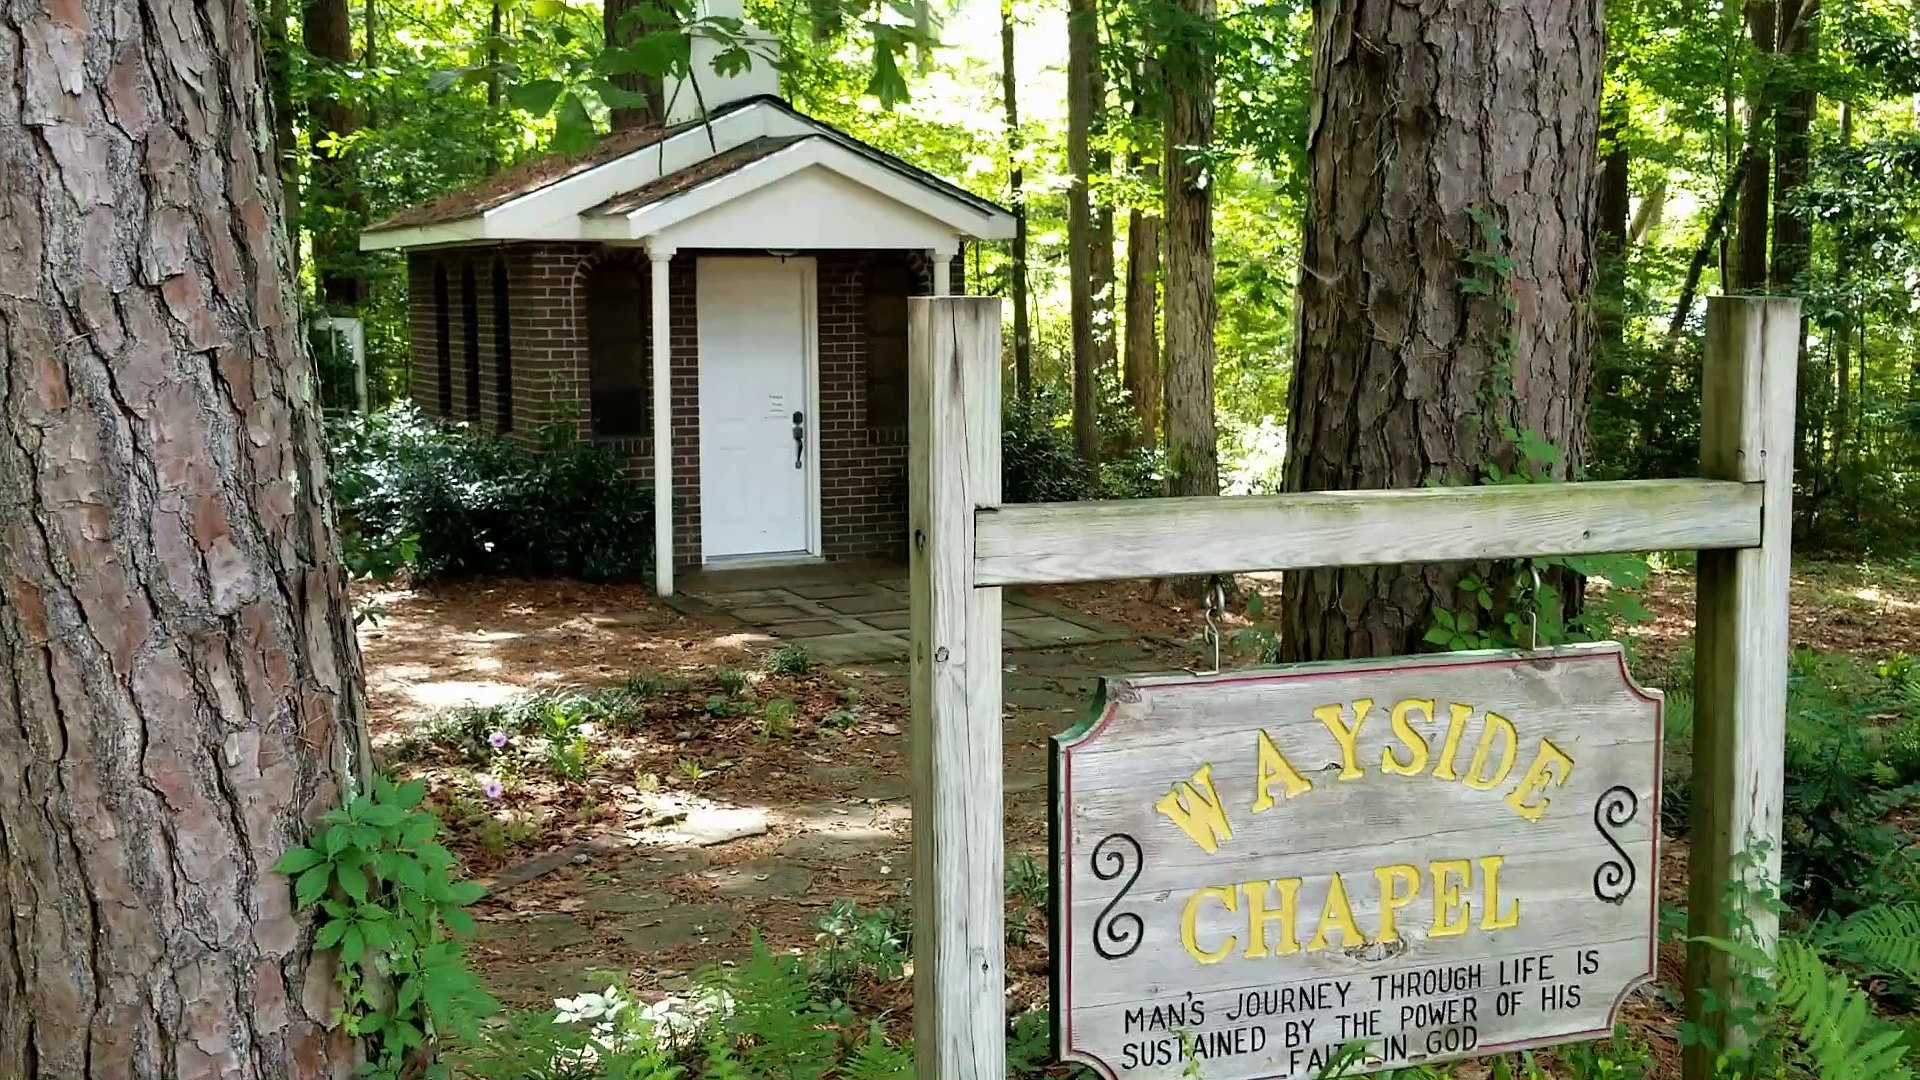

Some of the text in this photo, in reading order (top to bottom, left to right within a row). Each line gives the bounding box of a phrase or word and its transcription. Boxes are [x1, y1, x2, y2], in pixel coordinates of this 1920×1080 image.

[1155, 698, 1576, 854] WAYSIDE
[1179, 855, 1519, 965] CHAPEL
[1121, 984, 1582, 1070] SUSTAINED BY THE POWER OF HIS
[1124, 949, 1600, 1035] MAN'S JOURNEY THROUGH LIFE IS
[1384, 1034, 1408, 1062] IN
[1426, 1025, 1478, 1055] GOD
